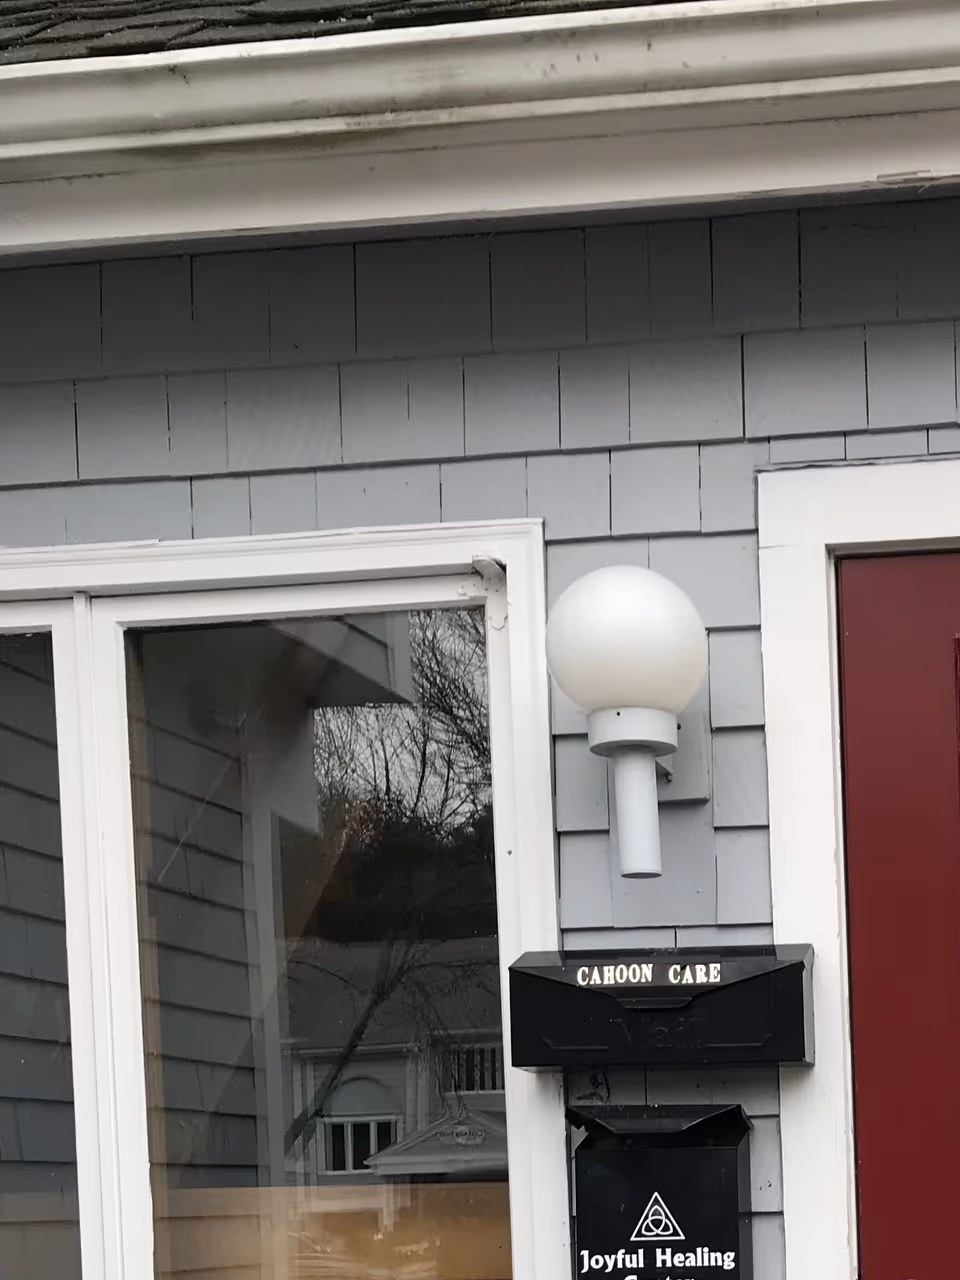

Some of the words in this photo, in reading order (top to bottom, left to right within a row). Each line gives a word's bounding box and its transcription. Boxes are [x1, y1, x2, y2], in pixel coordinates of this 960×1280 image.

[576, 963, 654, 986] CAHOON
[668, 963, 722, 984] CARE
[580, 1248, 645, 1273] Joyful
[655, 1247, 736, 1270] Healing
